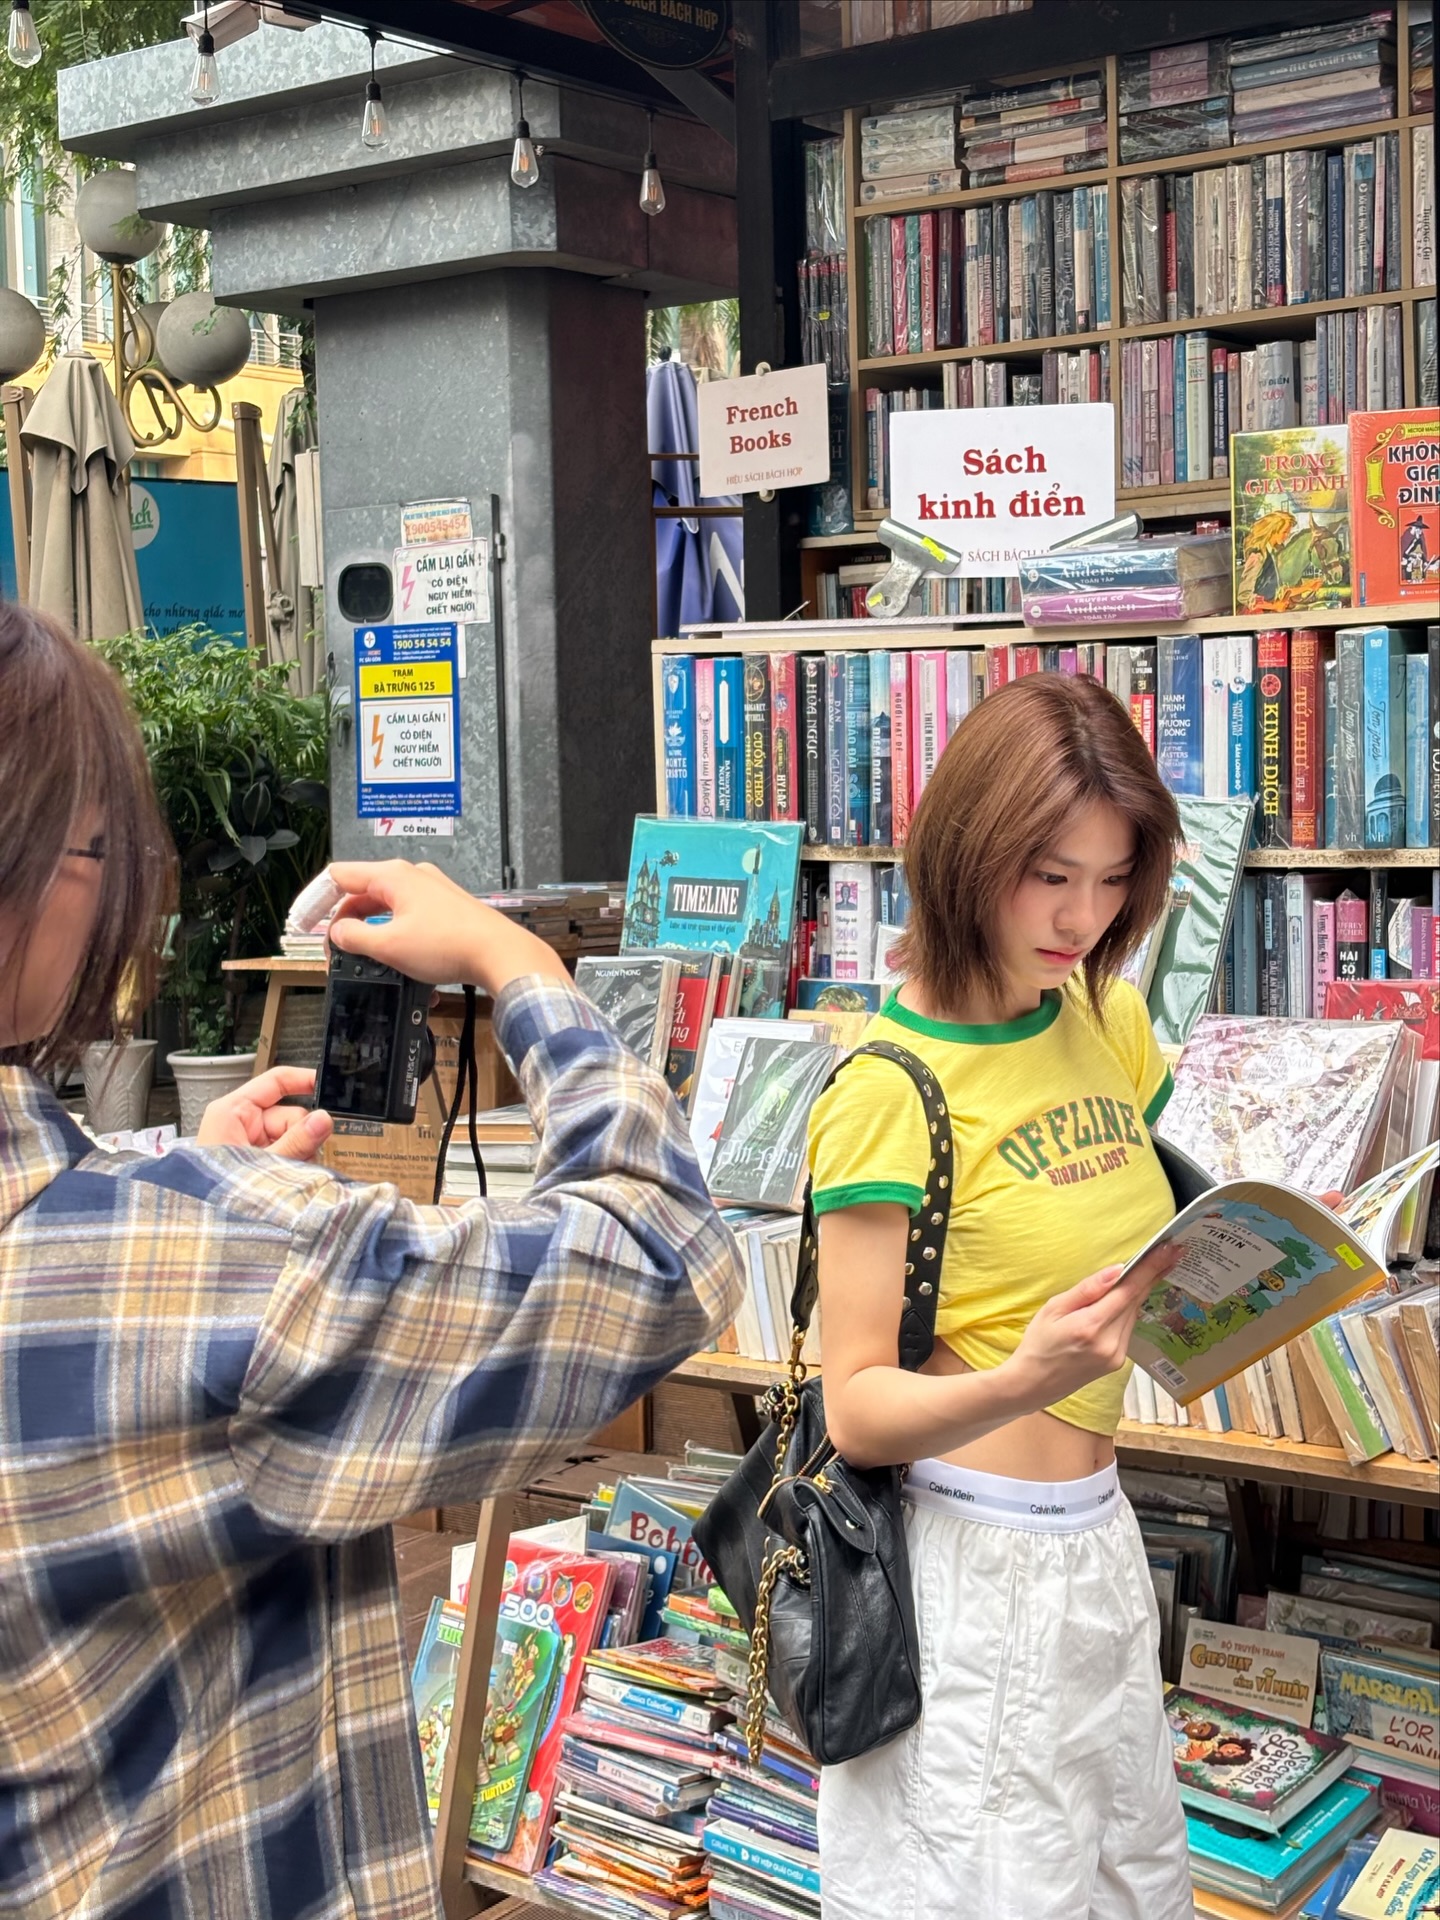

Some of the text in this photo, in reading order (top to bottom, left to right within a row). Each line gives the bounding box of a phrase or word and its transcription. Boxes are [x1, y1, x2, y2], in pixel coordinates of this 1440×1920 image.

[1041, 267, 1052, 315] MACHIAVELLI
[726, 396, 798, 425] French
[729, 429, 792, 455] Books
[963, 445, 1047, 476] Sách
[1260, 452, 1336, 473] TRONG
[726, 466, 803, 486] HIỆU SÁCH BÁCH HỢP
[1406, 465, 1440, 482] GIA
[1244, 472, 1348, 500] GIA ĐÌNH
[917, 482, 1086, 520] kinh điển
[416, 554, 437, 573] CẤM
[439, 556, 454, 573] LẠI
[456, 549, 475, 568] GẦN
[967, 547, 1001, 563] SÁCH
[431, 576, 468, 588] CÓ ĐIỆN
[428, 587, 473, 602] NGUY HIỂM
[144, 602, 245, 623] cho những giấc mơ
[426, 602, 476, 616] CHẾT NGƯỜI
[1064, 603, 1137, 616] Andersen
[393, 638, 452, 650] 1900 54 54 54
[392, 669, 414, 680] TRẠM
[374, 682, 435, 694] BÀ TRƯNG 125
[806, 683, 822, 715] HỎA
[386, 711, 406, 724] CẤM
[407, 716, 420, 726] LẠI
[422, 710, 441, 723] GẦN
[834, 700, 842, 723] DAN
[400, 729, 432, 742] CÓ ĐIỆN
[847, 711, 858, 744] PHÁO
[1294, 686, 1313, 770] TỨ THƯ
[394, 741, 440, 754] NGUY HIỂM
[805, 720, 818, 760] NGỤC
[392, 756, 442, 768] CHẾT NGƯỜI
[666, 758, 688, 768] MONTE
[1260, 702, 1279, 816] KINH DỊCH
[753, 732, 766, 808] CUỐN THEO
[776, 774, 786, 788] HY
[700, 778, 714, 818] MARGOT
[403, 824, 437, 836] CÓ ĐIỆN
[1344, 832, 1357, 842] vh
[672, 883, 740, 915] TIMELINE
[1340, 951, 1358, 961] HAI
[1342, 962, 1356, 974] SỐ
[997, 1095, 1144, 1181] OFFLINE
[1045, 1146, 1130, 1186] SIGNAL LOST
[1206, 1228, 1246, 1250] TINTIN
[928, 1481, 975, 1502] Calvin Klein
[1030, 1504, 1066, 1515] Calvin Klein
[502, 1592, 555, 1627] 500
[1190, 1643, 1253, 1673] GIEO HẠT
[1220, 1640, 1286, 1659] BỘ TRUYỆN TRANH
[1255, 1667, 1276, 1694] VĨ
[1273, 1678, 1310, 1701] NHÂN
[646, 1697, 675, 1713] Collection
[1390, 1715, 1434, 1744] L'OR
[1230, 1733, 1299, 1787] Garden
[1254, 1750, 1311, 1790] Secret
